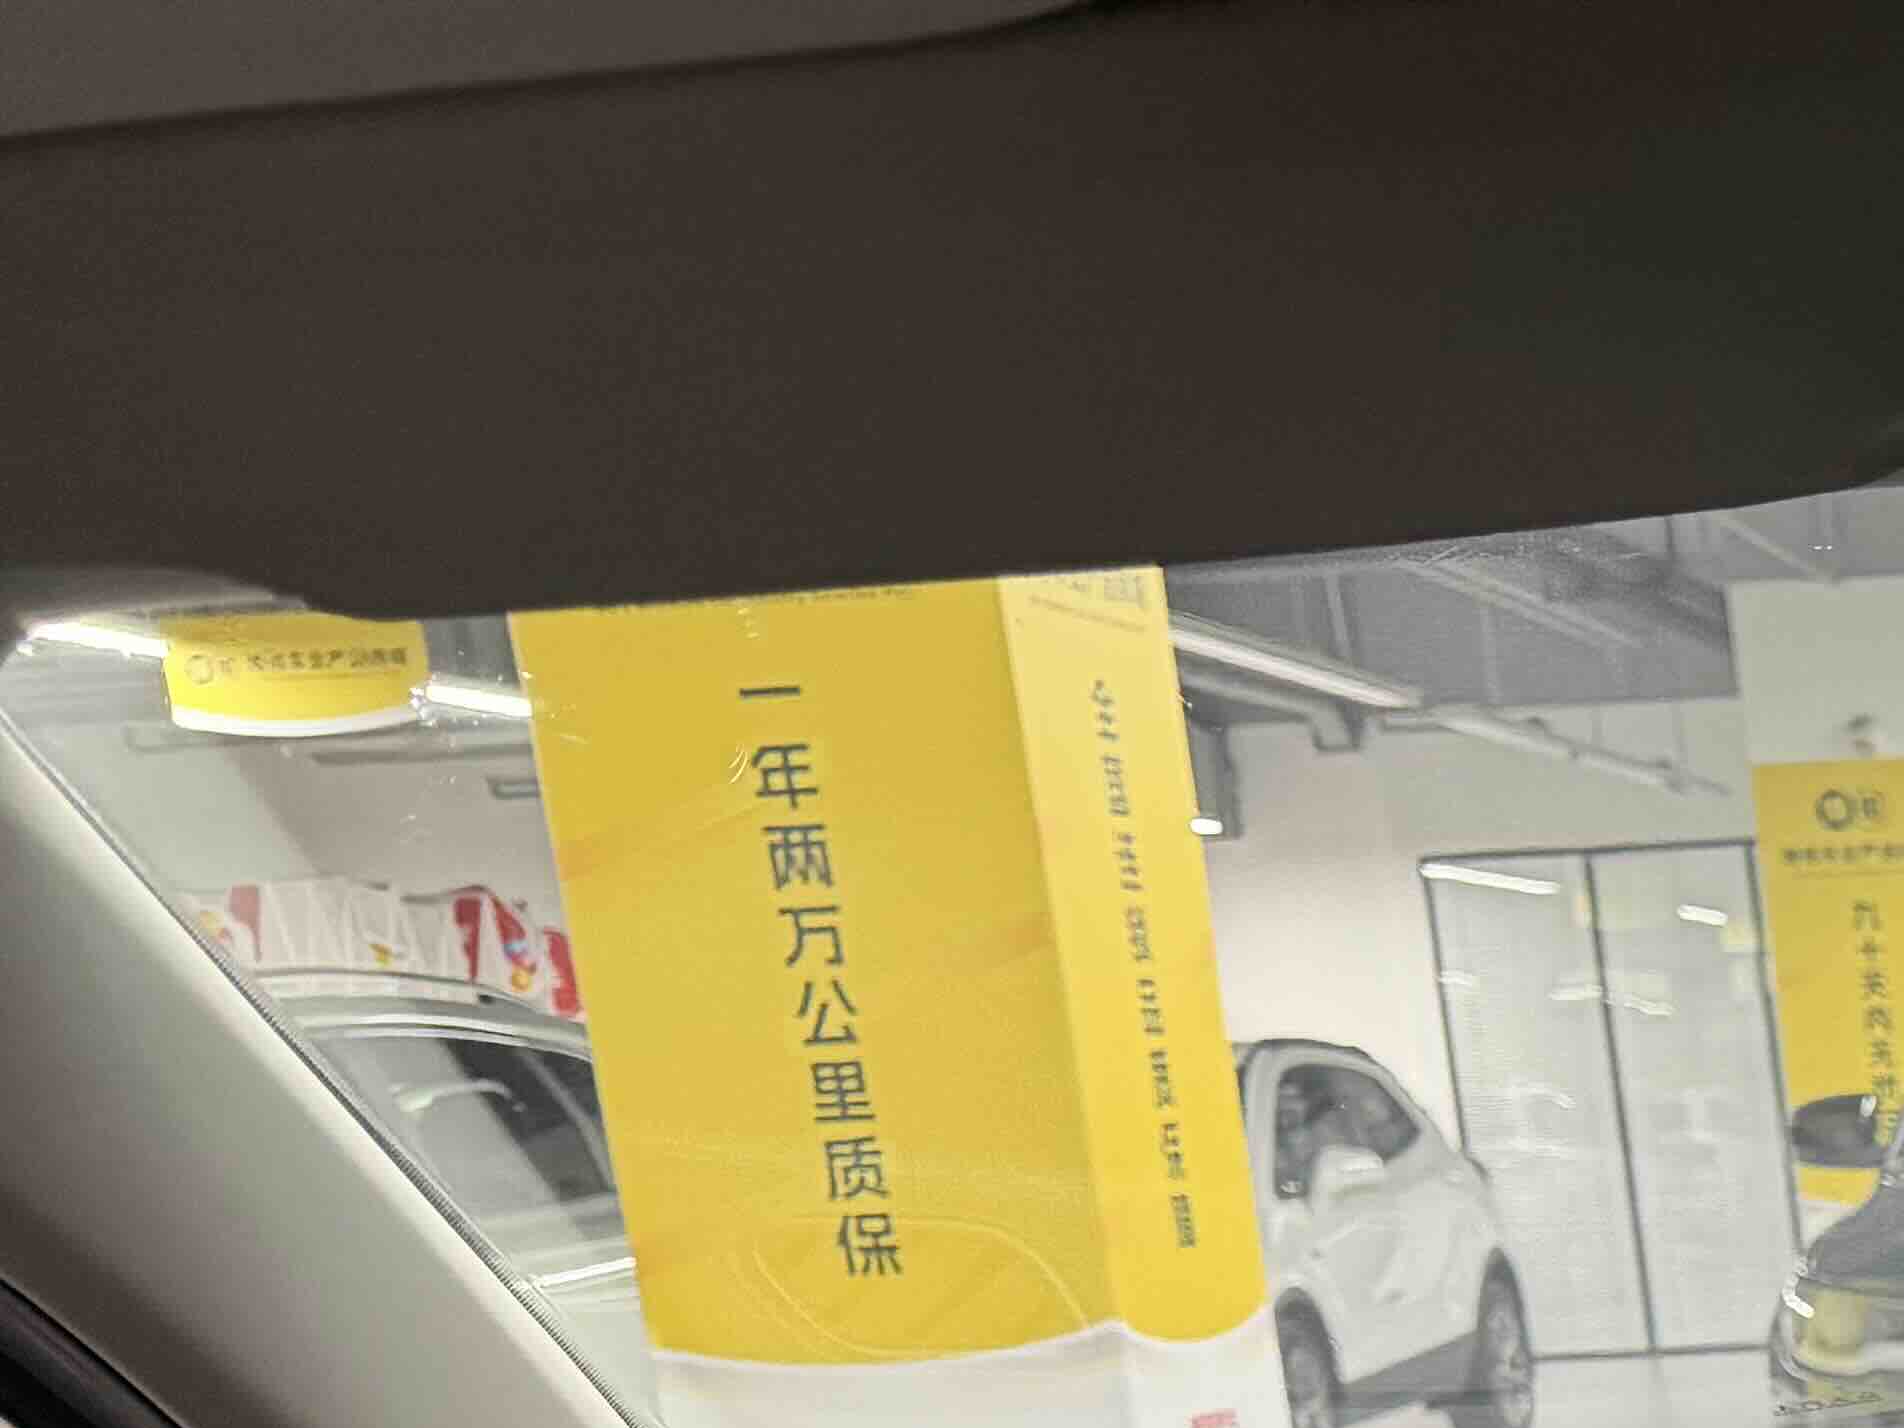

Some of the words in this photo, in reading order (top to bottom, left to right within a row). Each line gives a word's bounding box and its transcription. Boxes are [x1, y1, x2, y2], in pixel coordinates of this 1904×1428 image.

[738, 684, 902, 1276] 一年两万公里质保
